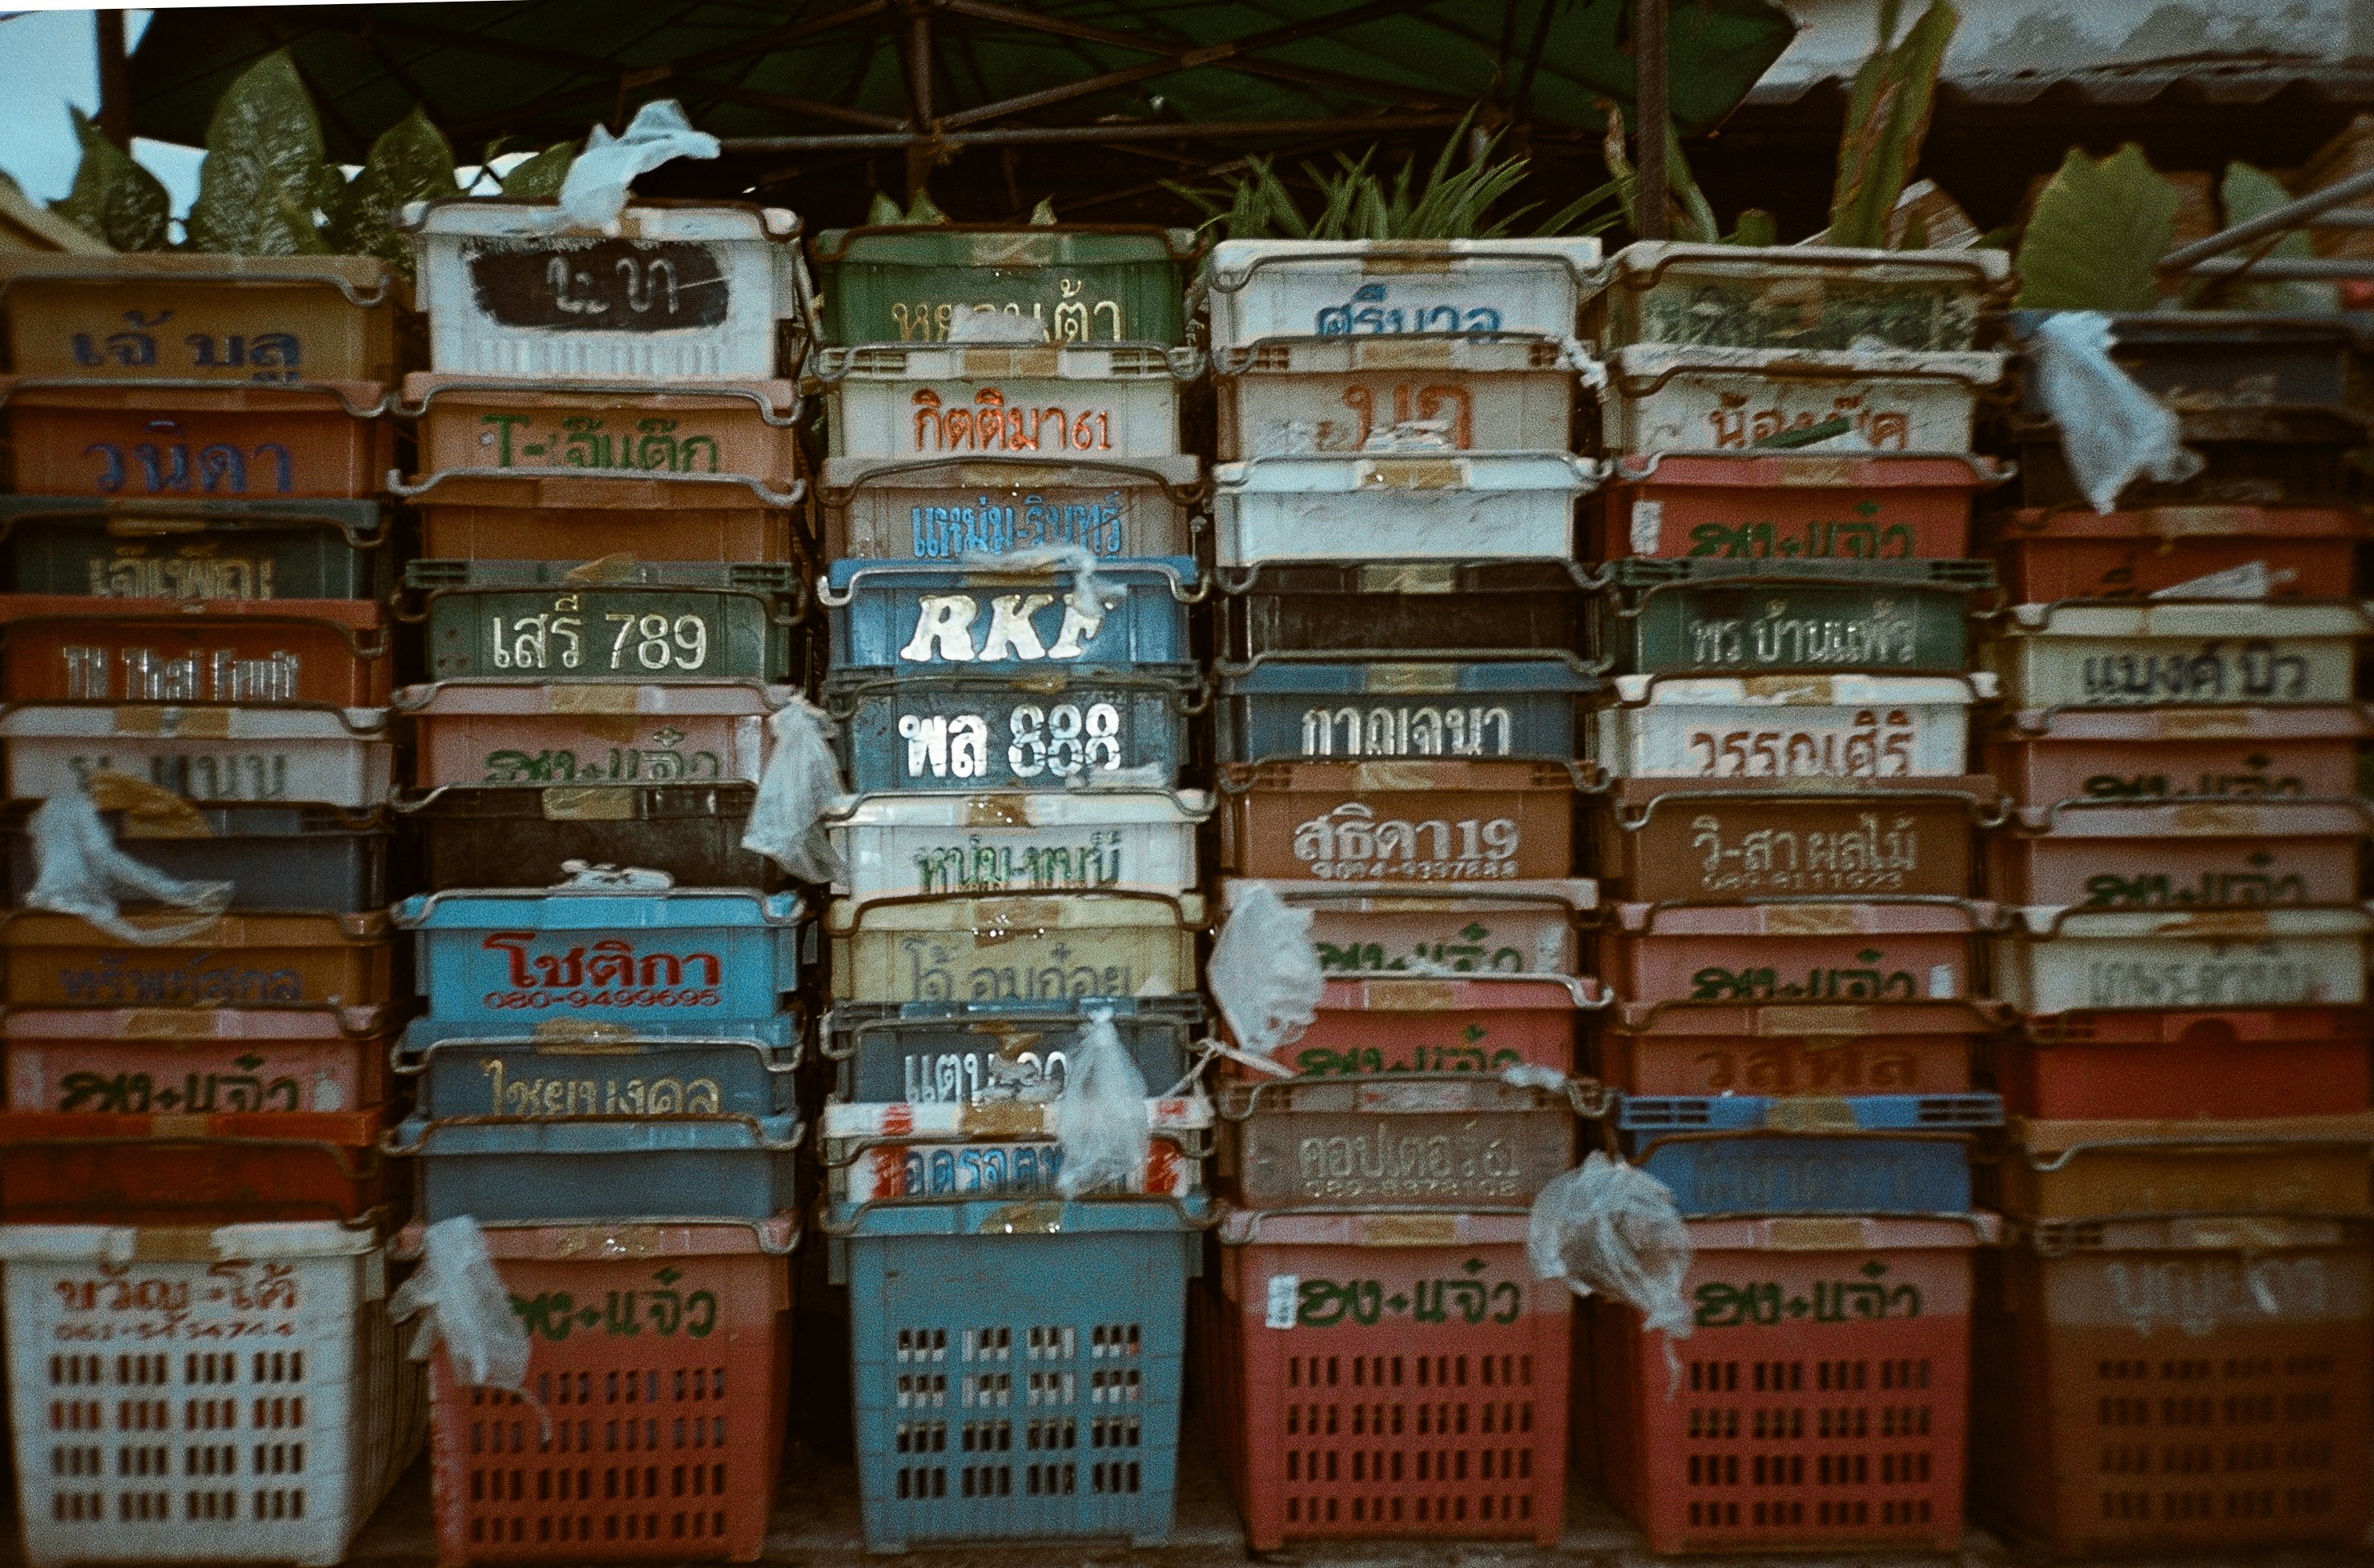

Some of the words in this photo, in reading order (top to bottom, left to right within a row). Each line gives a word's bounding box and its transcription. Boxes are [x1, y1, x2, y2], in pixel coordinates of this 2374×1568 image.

[493, 594, 583, 669] เสรี
[605, 613, 707, 671] 789
[898, 714, 989, 778] พล
[1008, 702, 1122, 778] 888
[1301, 706, 1509, 757] กาญจนา
[481, 932, 722, 989] โชติกา
